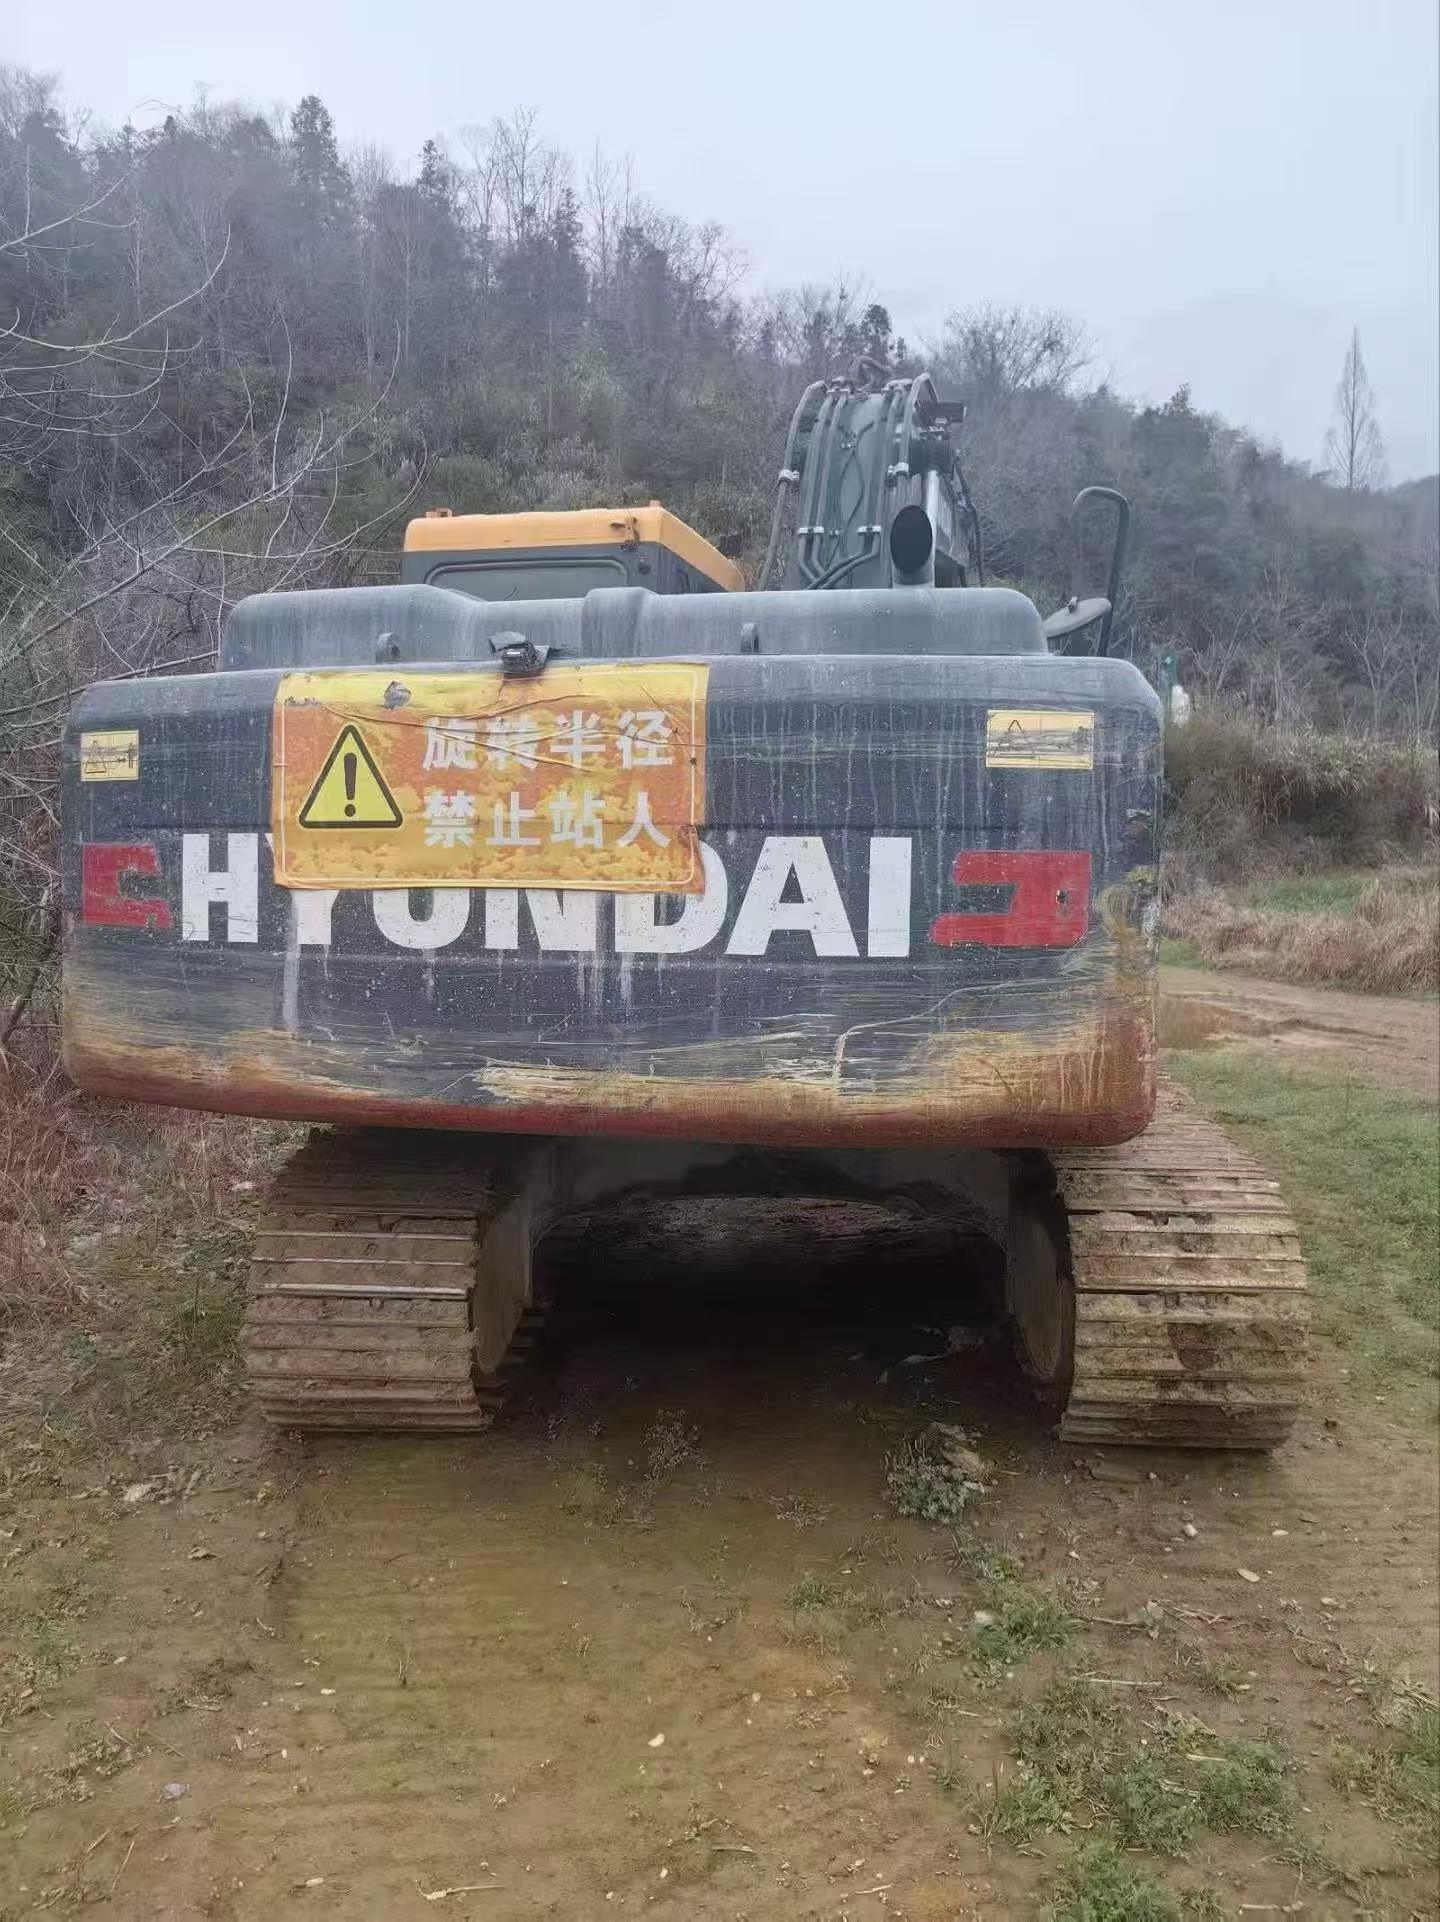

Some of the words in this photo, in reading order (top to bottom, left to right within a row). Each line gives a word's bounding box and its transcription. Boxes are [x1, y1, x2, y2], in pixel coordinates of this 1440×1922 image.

[422, 710, 673, 771] 旋转半径
[422, 790, 672, 848] 禁止站人
